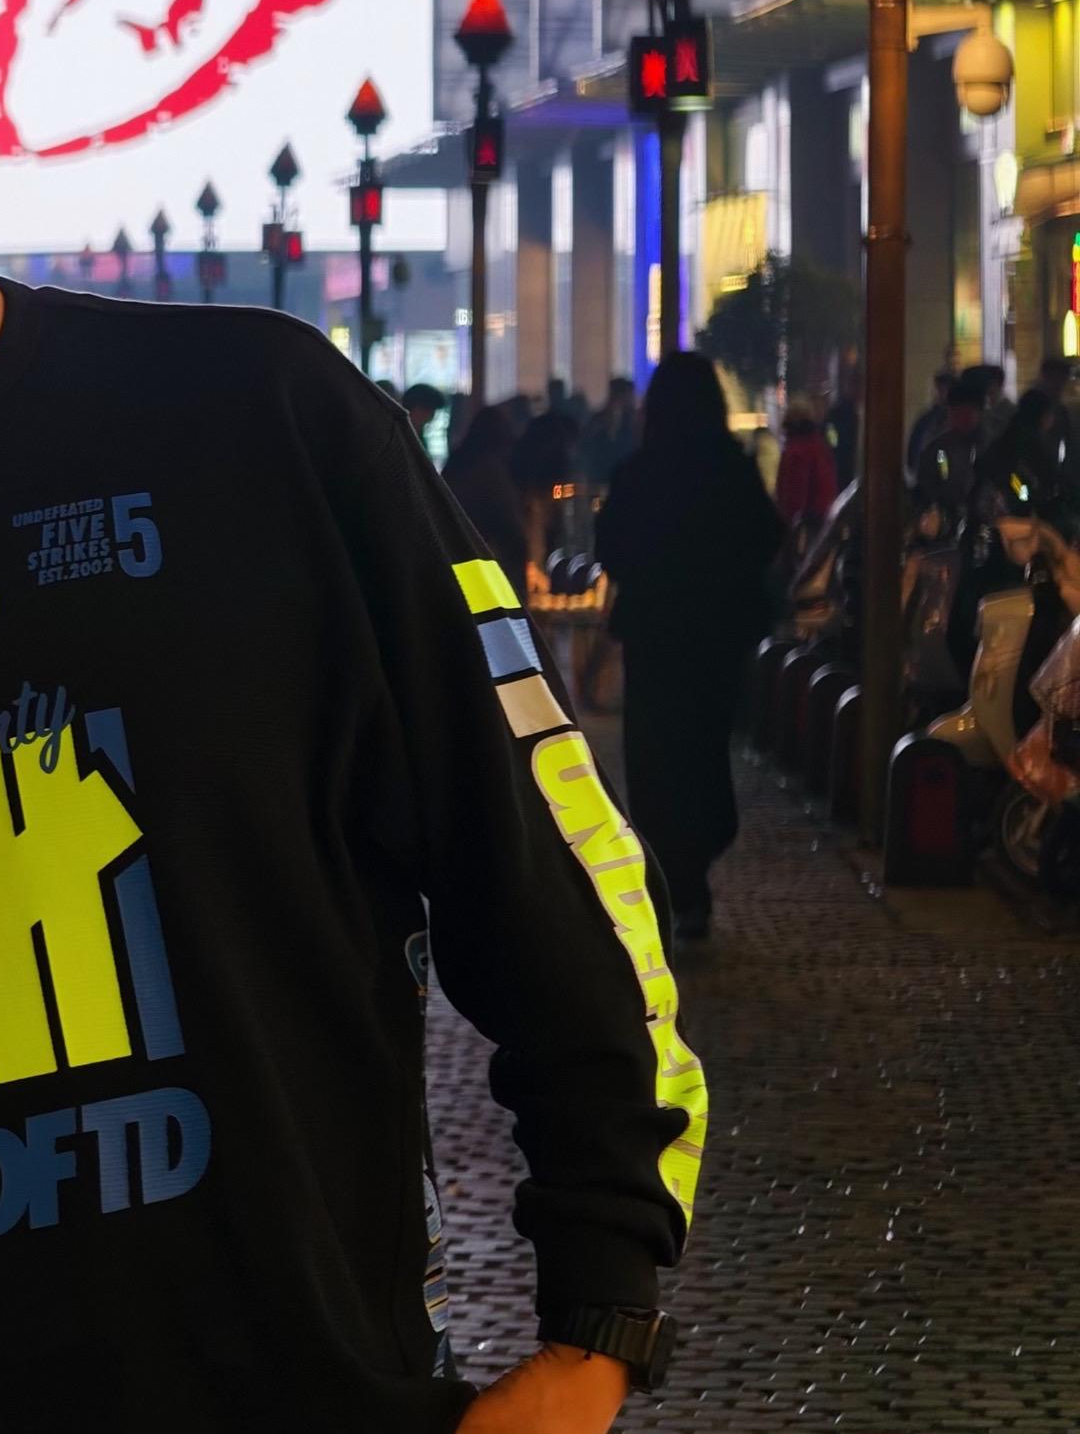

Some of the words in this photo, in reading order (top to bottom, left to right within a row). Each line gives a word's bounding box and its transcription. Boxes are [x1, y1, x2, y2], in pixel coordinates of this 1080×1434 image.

[12, 498, 105, 528] UNDEFEATED
[41, 513, 105, 548] FIVE
[111, 492, 163, 578] 5
[27, 538, 111, 571] STRIKES
